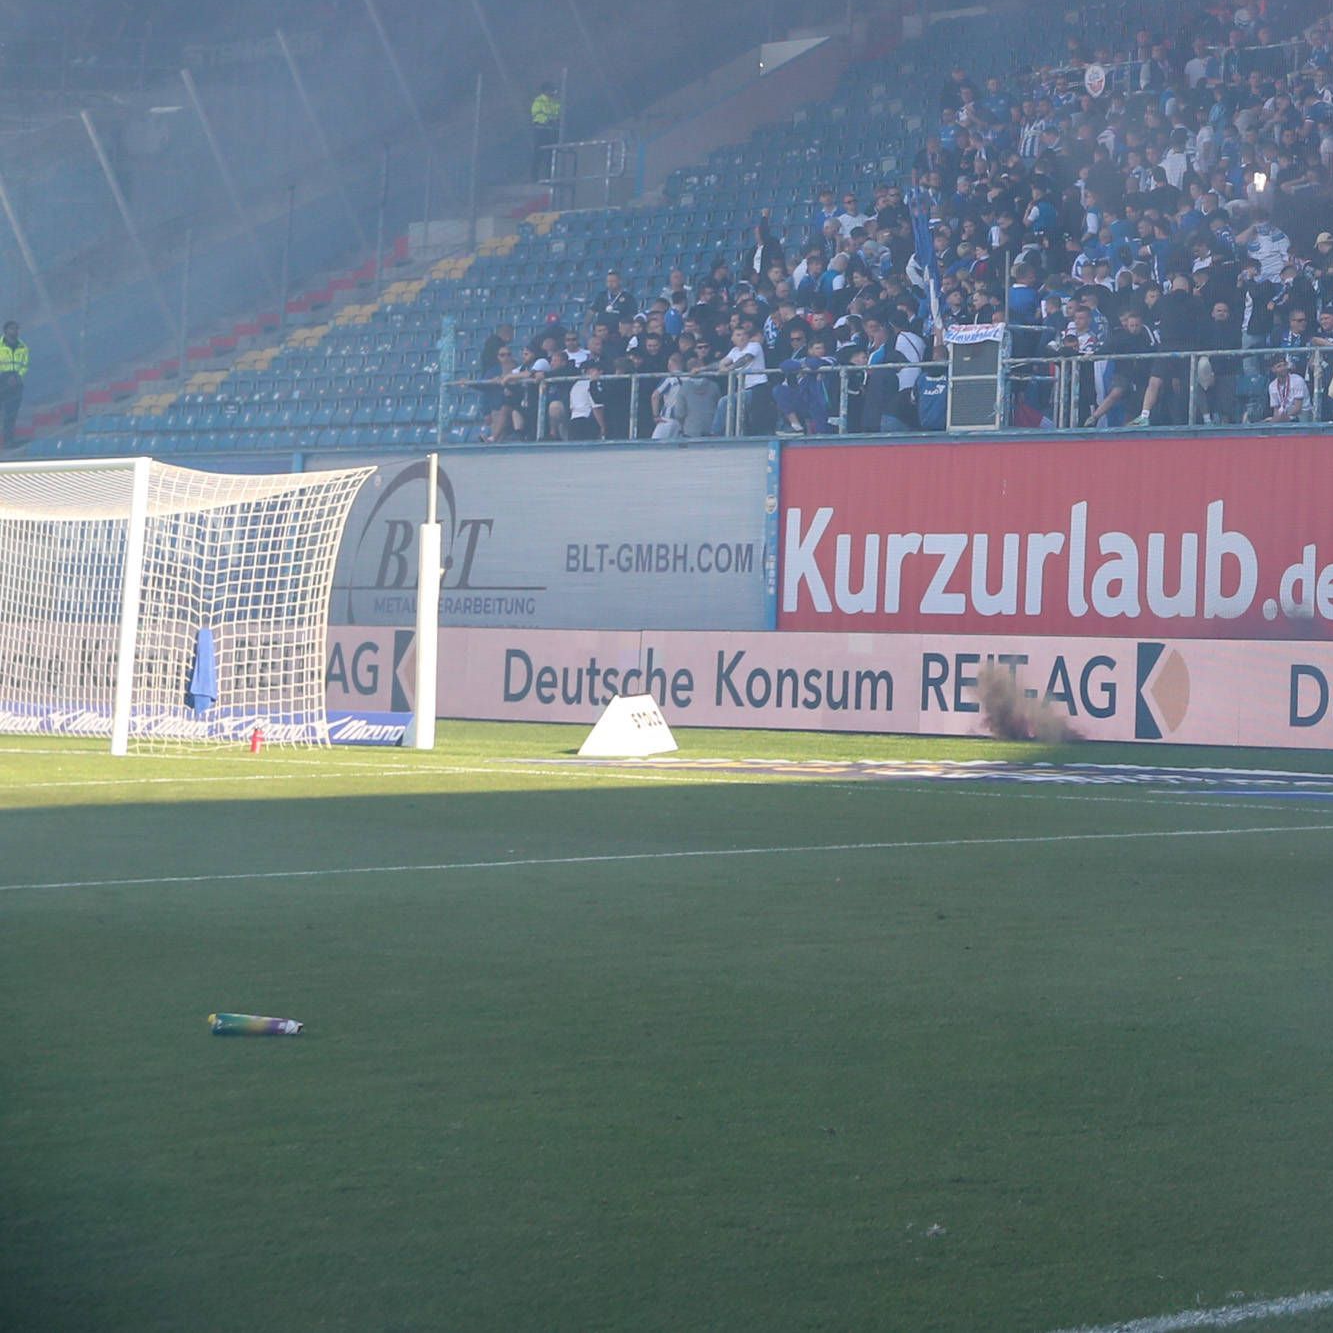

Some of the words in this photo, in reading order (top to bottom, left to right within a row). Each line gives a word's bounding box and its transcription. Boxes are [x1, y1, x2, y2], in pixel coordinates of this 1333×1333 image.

[374, 518, 494, 588] BT
[565, 542, 754, 575] BLT-GMBH.COM
[503, 649, 694, 708] Deutsche
[716, 650, 893, 712] Konsum
